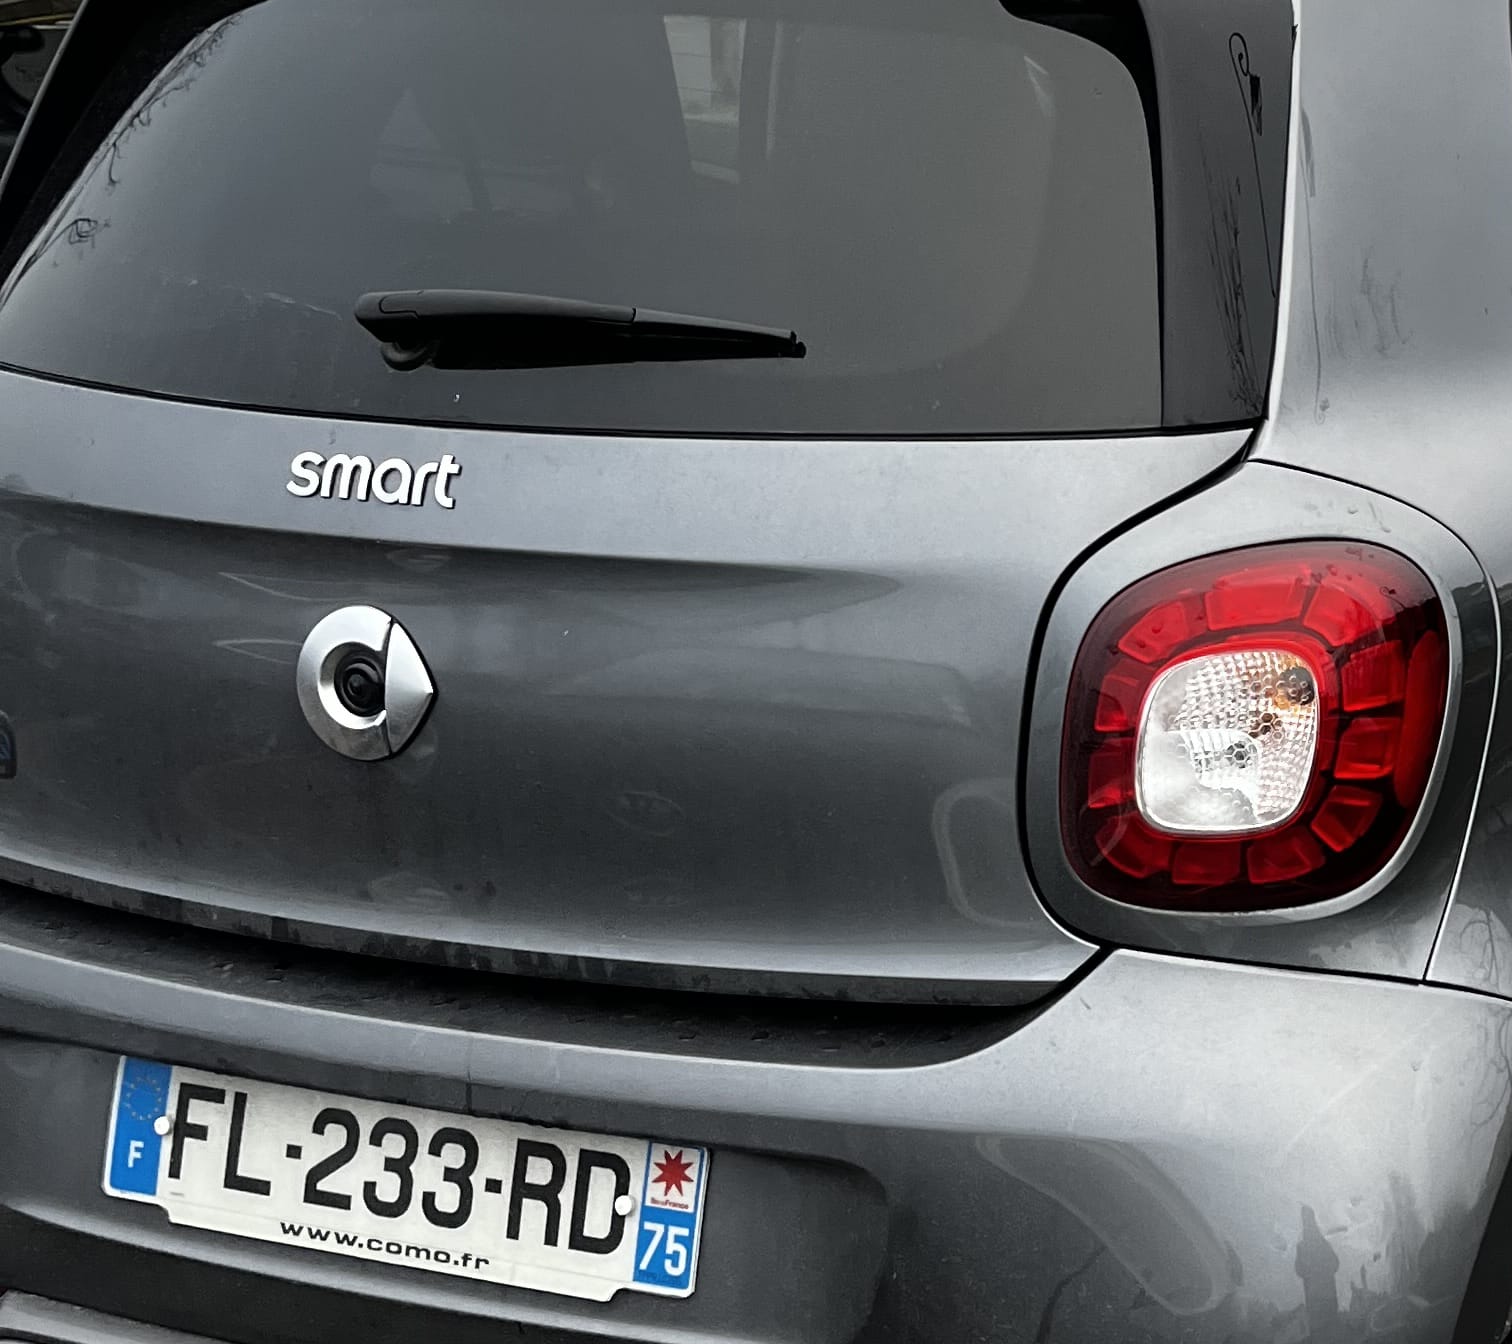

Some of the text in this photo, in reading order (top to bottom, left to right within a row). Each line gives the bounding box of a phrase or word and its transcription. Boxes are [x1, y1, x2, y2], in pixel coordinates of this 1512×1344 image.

[286, 451, 461, 509] smart
[127, 1140, 144, 1168] F
[168, 1082, 631, 1255] FL-233-RD
[280, 1222, 490, 1271] www.como.fr
[640, 1221, 689, 1276] 75
